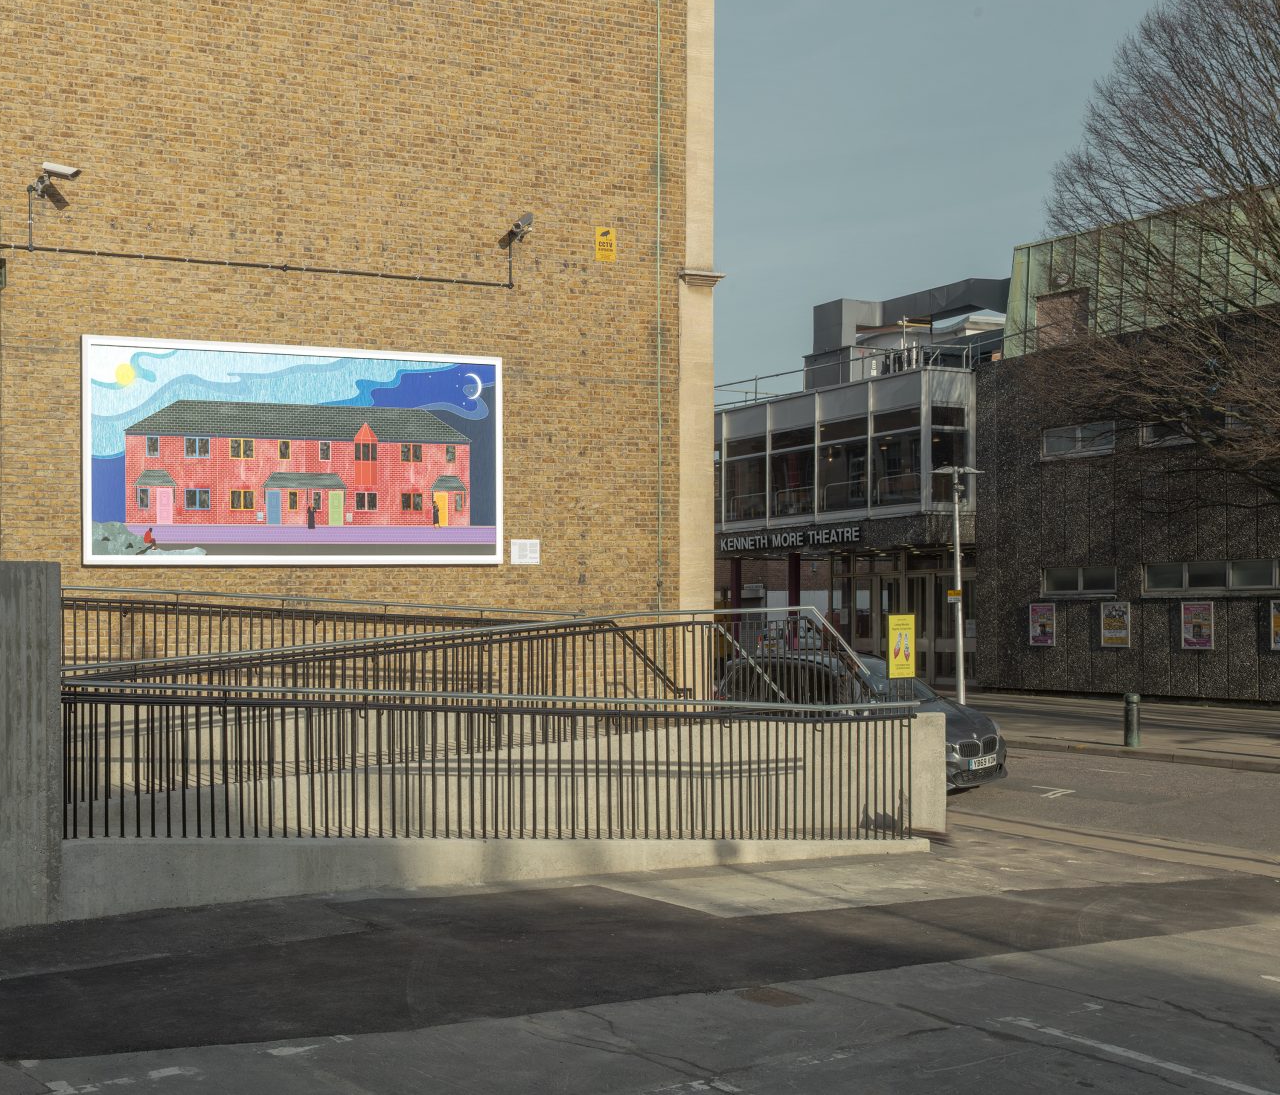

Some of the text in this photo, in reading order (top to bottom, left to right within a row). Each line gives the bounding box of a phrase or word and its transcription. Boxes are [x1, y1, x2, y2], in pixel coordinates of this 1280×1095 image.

[720, 526, 860, 552] KENNETH MORE THEATRE
